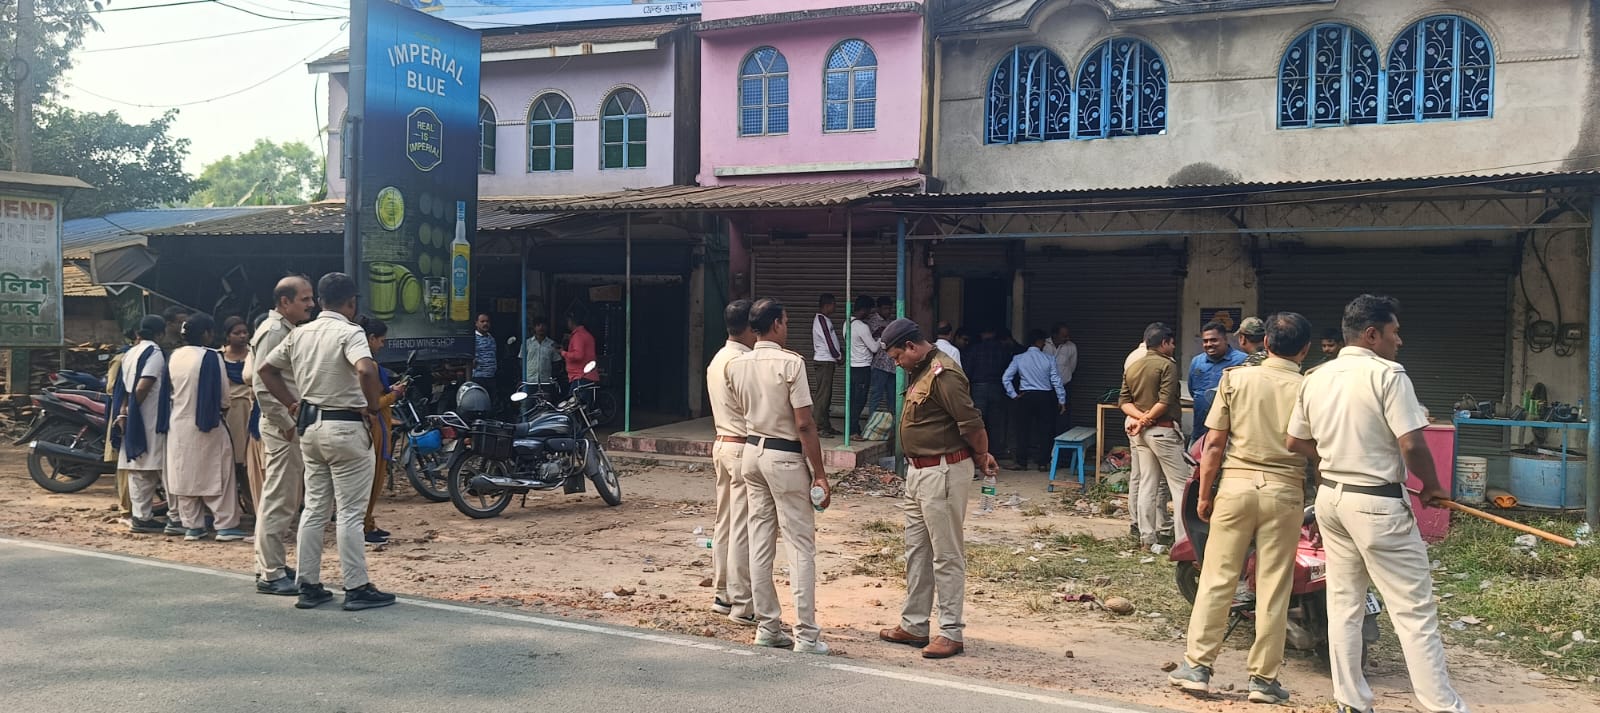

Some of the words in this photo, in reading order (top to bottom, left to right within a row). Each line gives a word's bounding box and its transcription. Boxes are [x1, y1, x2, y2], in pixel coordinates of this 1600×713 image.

[387, 43, 464, 86] IMPERIAL
[407, 70, 446, 96] BLUE
[416, 120, 435, 133] REAL
[421, 132, 430, 141] IS
[409, 142, 440, 159] IMPERIAL
[388, 339, 415, 349] FRIEND
[416, 338, 435, 348] WINE
[436, 337, 456, 347] SHOP
